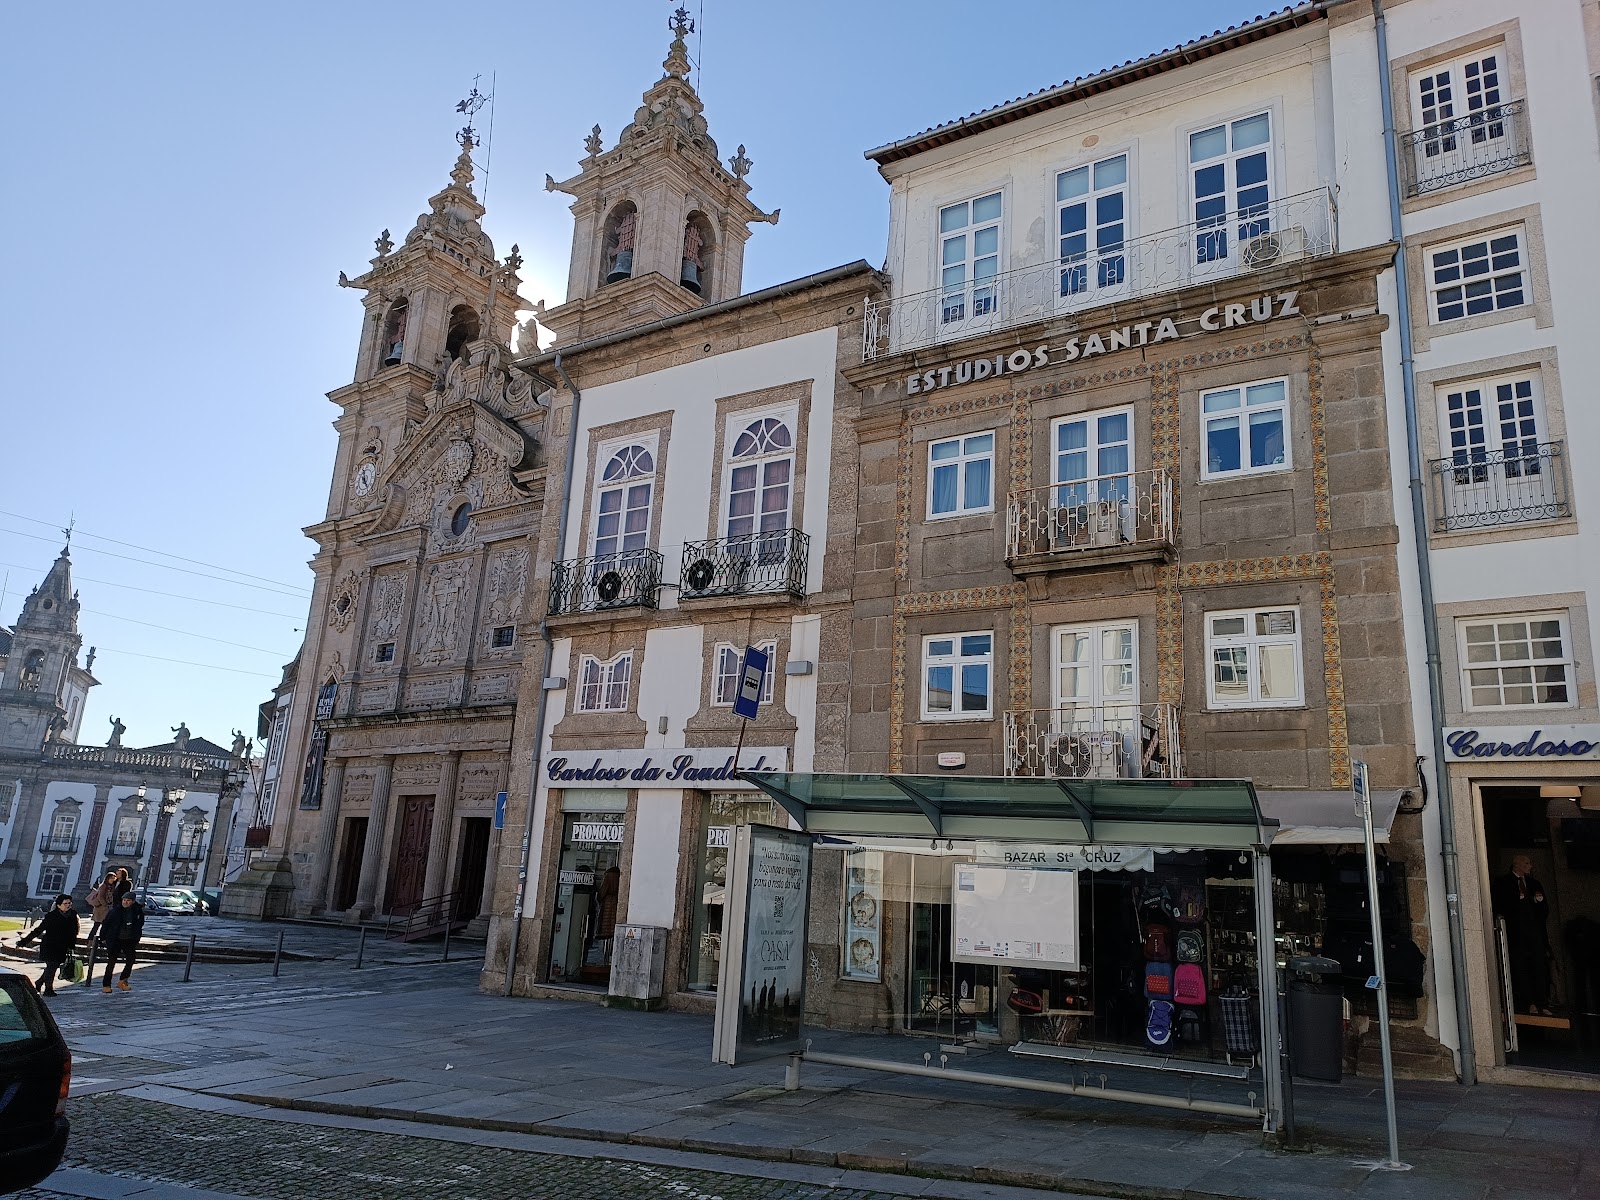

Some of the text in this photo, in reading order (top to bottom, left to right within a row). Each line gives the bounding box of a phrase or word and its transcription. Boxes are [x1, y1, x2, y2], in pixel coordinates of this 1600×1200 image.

[907, 290, 1300, 395] ESTÚDIOS SANTA CRUZ
[1447, 730, 1600, 757] Cardoso
[546, 757, 632, 781] Cardoso
[630, 757, 666, 781] da
[1004, 852, 1047, 863] BAZAR
[1085, 852, 1122, 863] CRUZ
